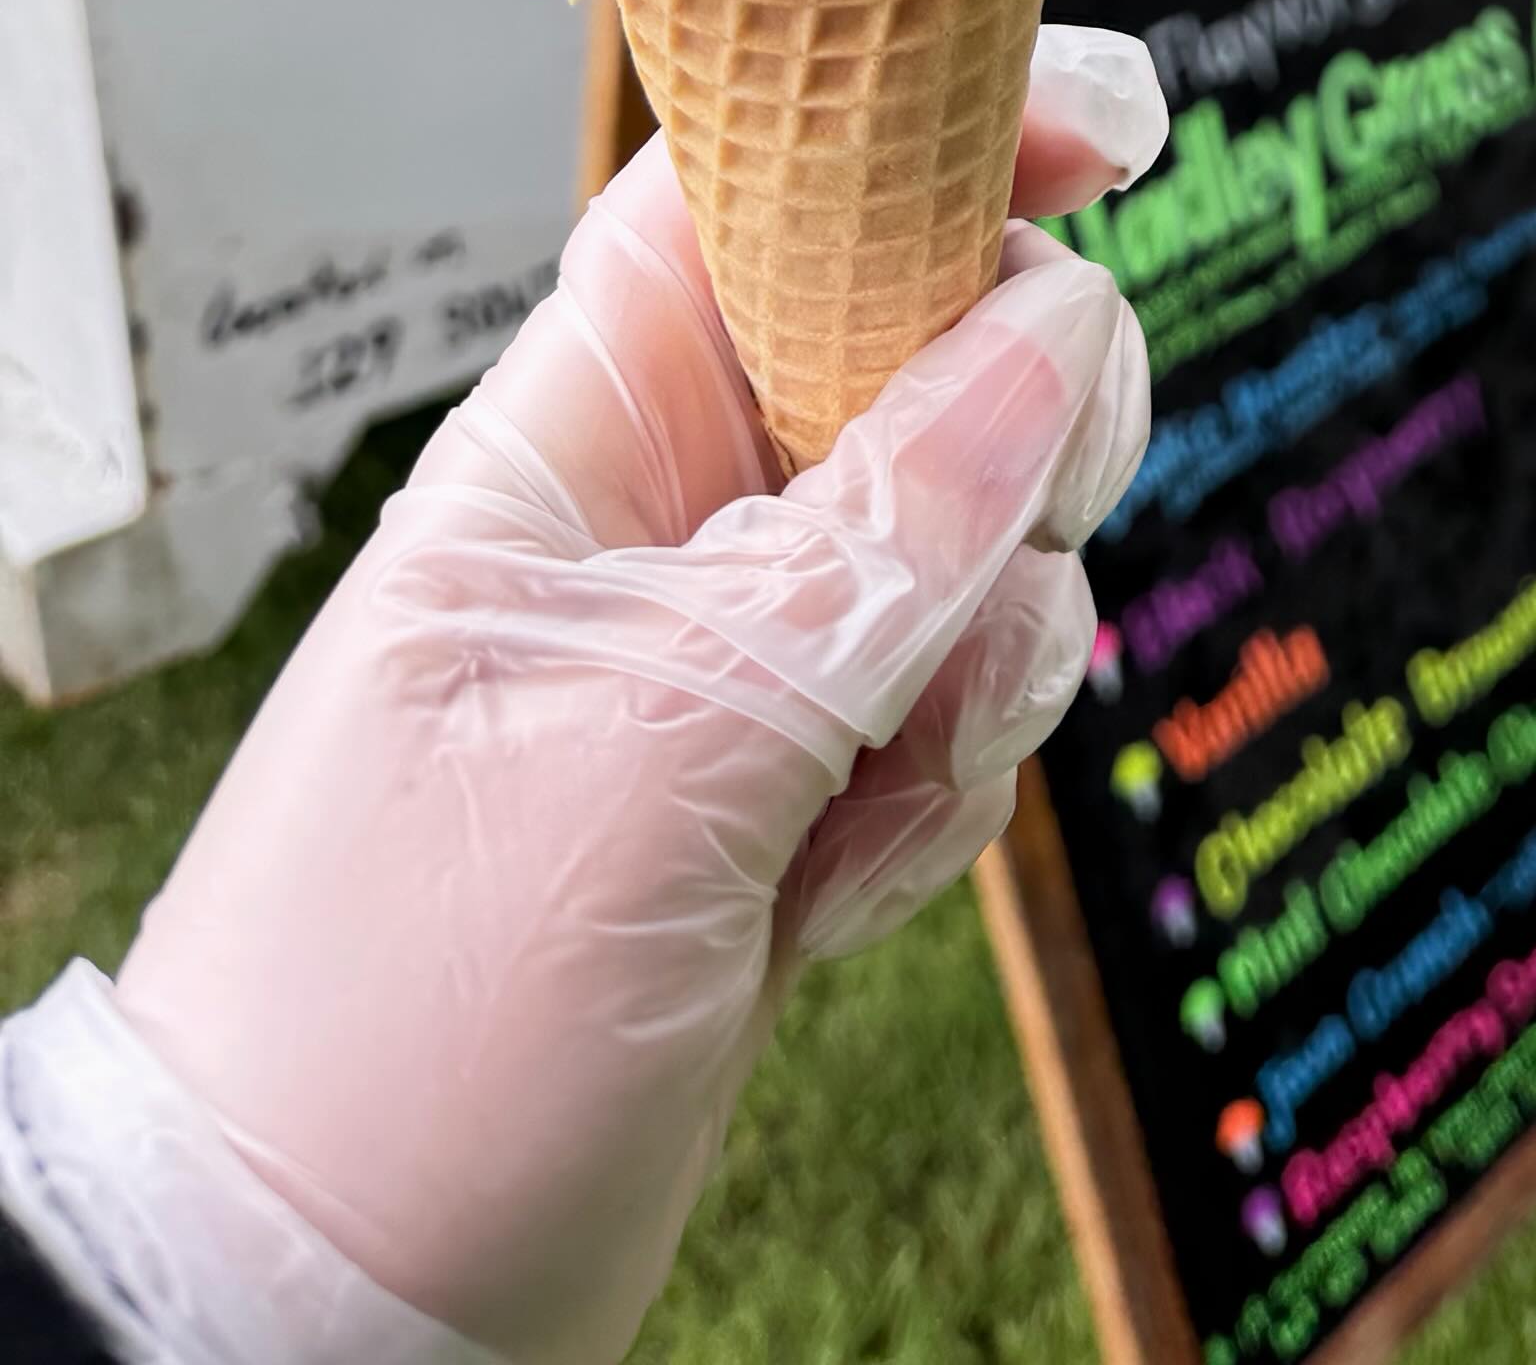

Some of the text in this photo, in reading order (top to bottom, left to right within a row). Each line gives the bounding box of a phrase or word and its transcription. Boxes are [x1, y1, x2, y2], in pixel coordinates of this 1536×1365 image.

[1151, 623, 1330, 781] Vanilla
[1194, 695, 1412, 921] Chocolate
[1216, 875, 1331, 1019] Mint
